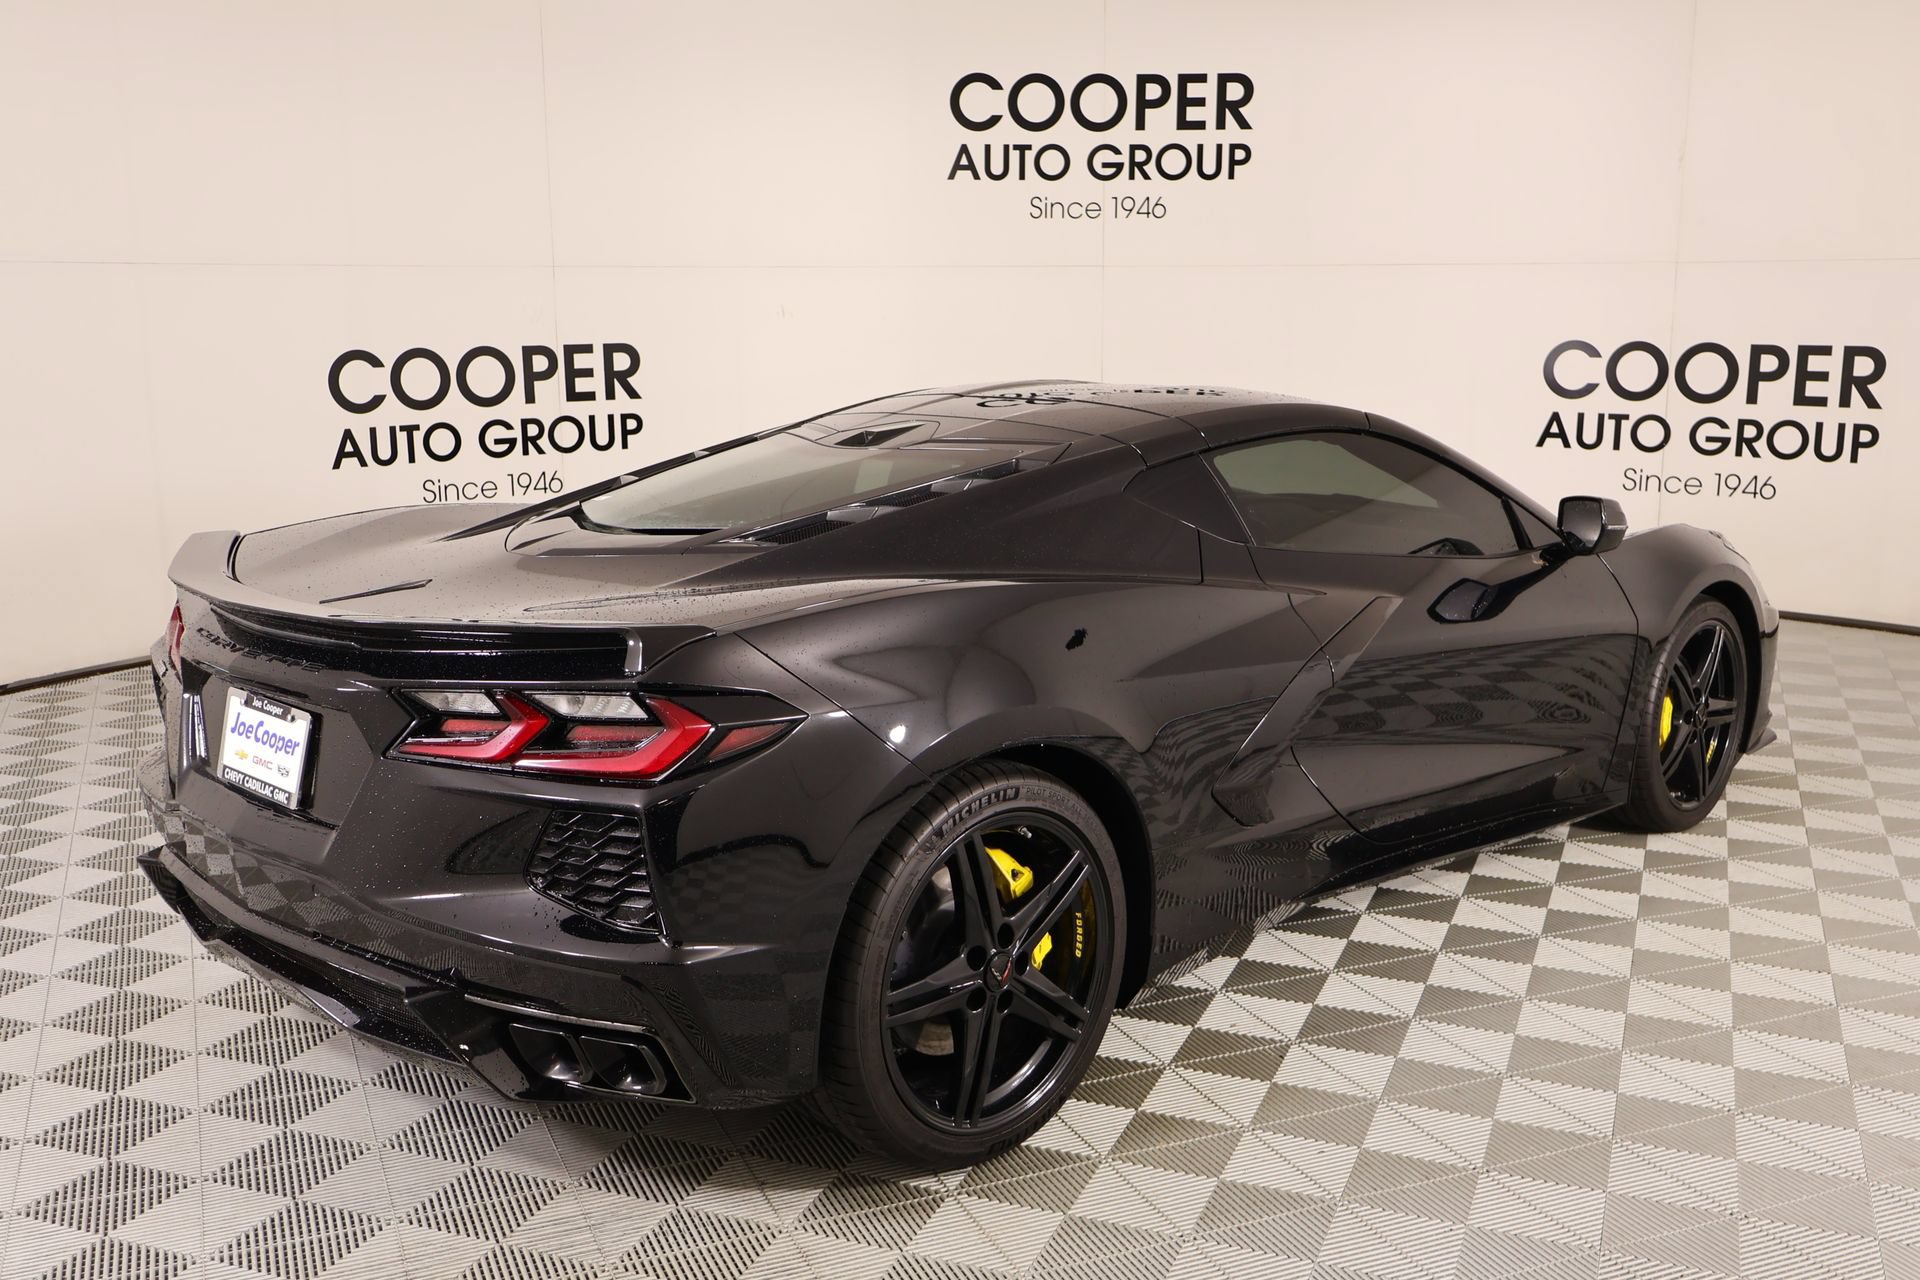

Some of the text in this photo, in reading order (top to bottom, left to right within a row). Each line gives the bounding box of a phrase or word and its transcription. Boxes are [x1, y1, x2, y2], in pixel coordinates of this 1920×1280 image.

[949, 72, 1255, 132] COOPER
[947, 143, 1252, 181] AUTO GROUP
[1029, 196, 1167, 219] Since 1946
[328, 343, 643, 414] COOPER
[1543, 340, 1887, 410] COOPER
[332, 413, 644, 470] AUTO GROUP
[1535, 411, 1880, 464] AUTO GROUP
[422, 470, 564, 503] Since 1946
[1622, 467, 1777, 500] Since 1946
[252, 696, 283, 715] Joe Cooper
[252, 755, 273, 771] GMC
[224, 767, 290, 805] CHEVY CADILLAC GMC
[942, 787, 1017, 837] MICHELIN
[1075, 912, 1083, 958] FORGED
